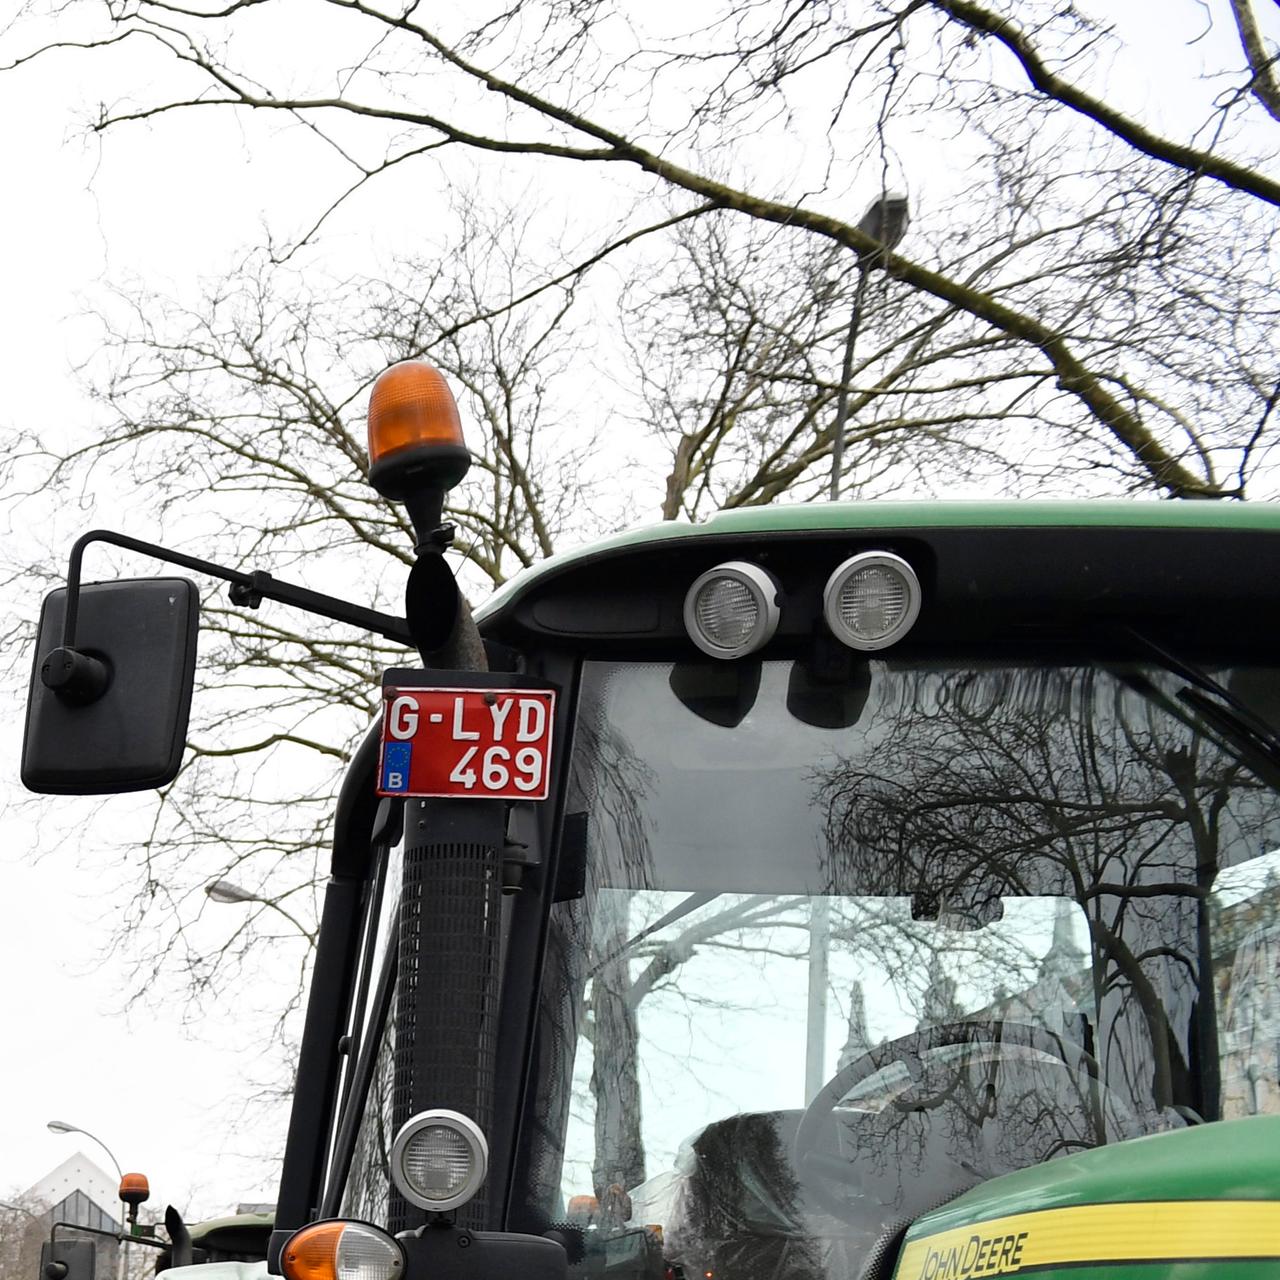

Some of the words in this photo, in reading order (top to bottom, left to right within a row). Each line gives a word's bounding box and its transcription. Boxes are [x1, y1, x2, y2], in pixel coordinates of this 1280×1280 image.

[389, 695, 546, 742] G-LYD
[387, 772, 403, 789] B
[449, 746, 543, 792] 469
[961, 1232, 1029, 1274] DEERE
